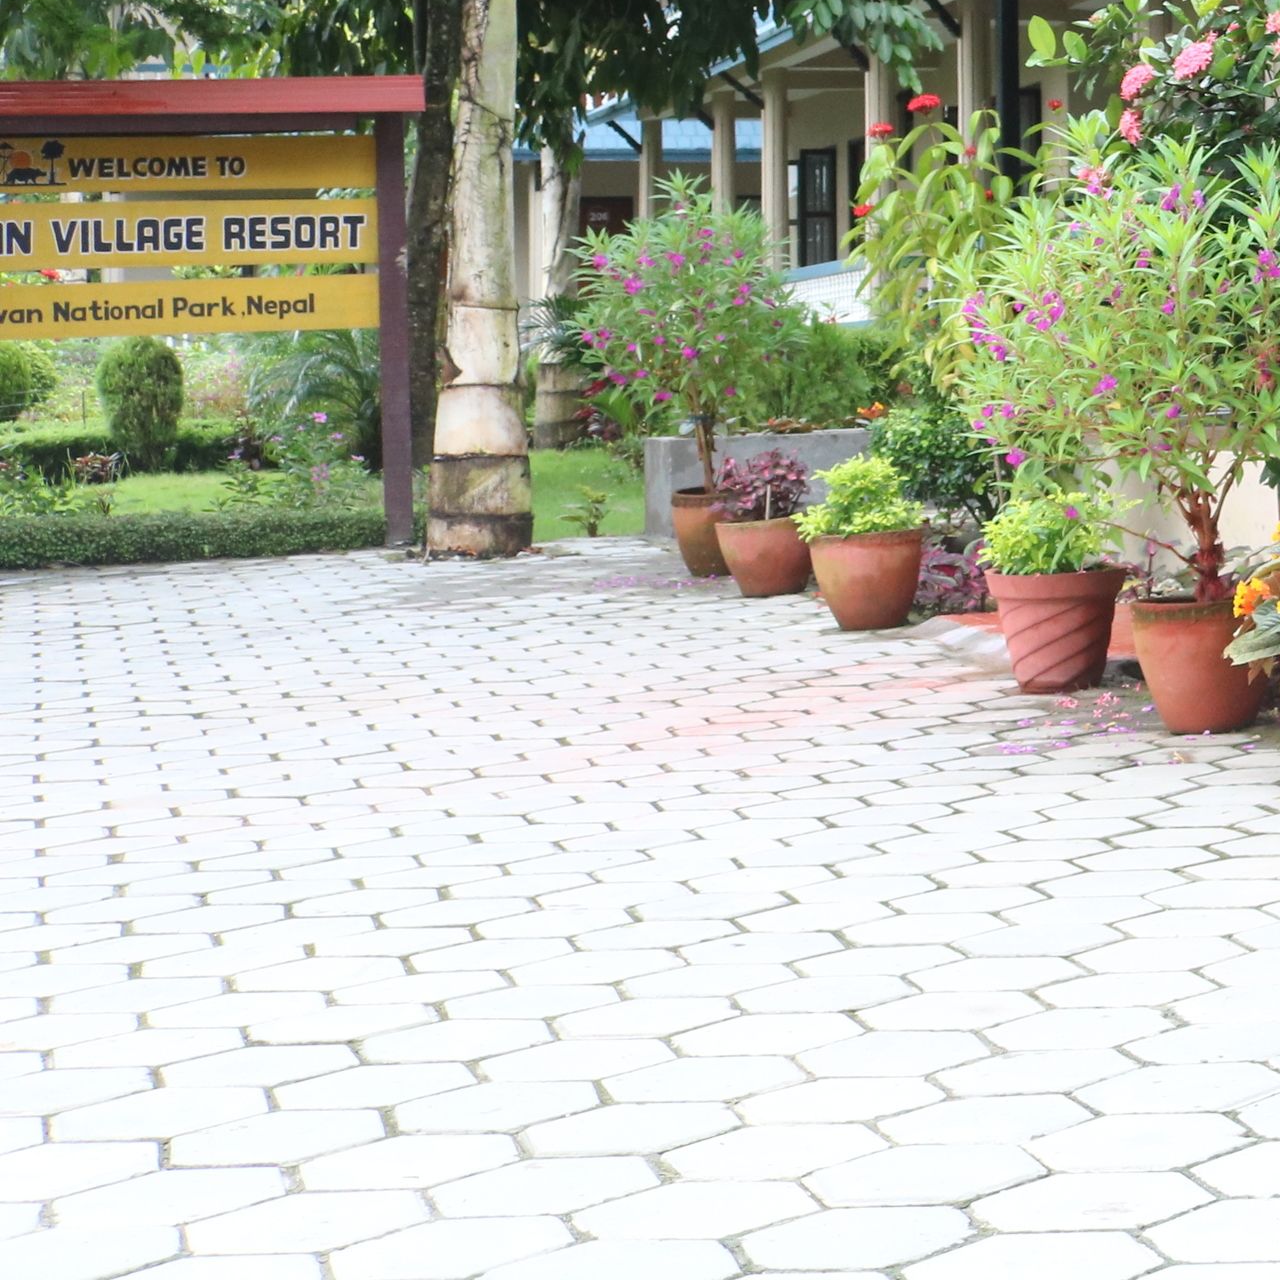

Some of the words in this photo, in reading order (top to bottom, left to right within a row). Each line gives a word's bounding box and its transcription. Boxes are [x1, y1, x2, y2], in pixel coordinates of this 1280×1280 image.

[68, 156, 208, 179] WELCOME
[216, 156, 246, 178] TO
[50, 216, 206, 255] VILLAGE
[223, 213, 367, 252] RESORT
[53, 299, 164, 322] National
[172, 296, 236, 318] Park
